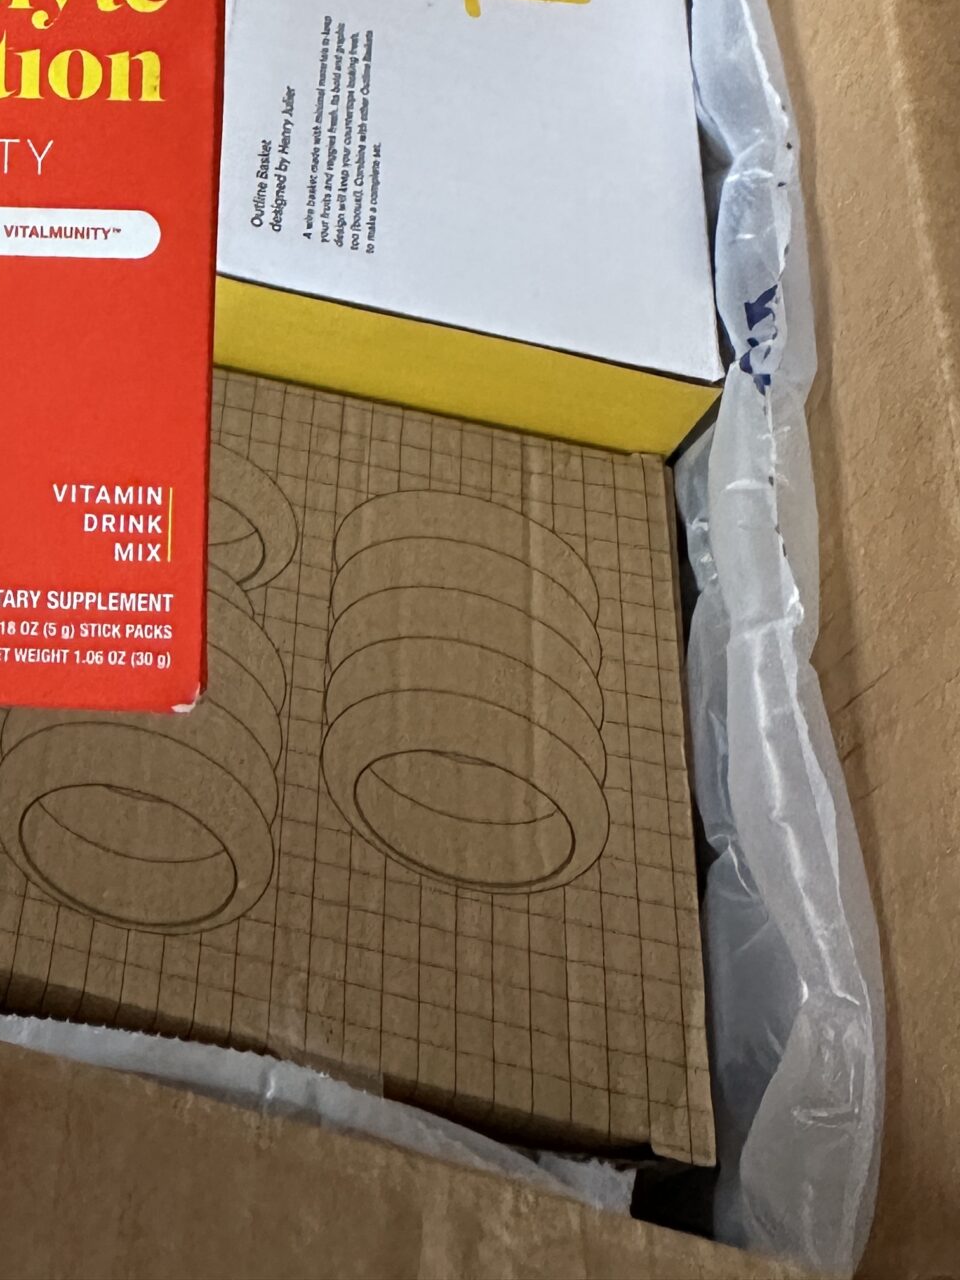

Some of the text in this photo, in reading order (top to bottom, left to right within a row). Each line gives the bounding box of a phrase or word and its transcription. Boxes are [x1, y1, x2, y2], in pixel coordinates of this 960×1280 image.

[278, 119, 294, 154] Henry
[275, 157, 291, 172] by
[250, 139, 272, 228] Outline Basket
[306, 175, 318, 207] basket
[324, 172, 334, 191] and
[269, 174, 287, 233] designed
[320, 194, 331, 218] fruits
[321, 221, 330, 243] your
[333, 214, 347, 248] design
[53, 484, 162, 505] VITAMIN
[84, 514, 162, 533] DRINK
[114, 543, 161, 562] MIX
[47, 591, 174, 612] SUPPLEMENT
[20, 621, 39, 636] OZ
[43, 622, 56, 638] (5
[62, 624, 75, 639] g)
[80, 623, 121, 638] STICK
[126, 624, 172, 639] PACKS
[15, 648, 69, 664] WEIGHT
[74, 650, 103, 665] 1.06
[108, 651, 126, 665] OZ
[131, 652, 153, 668] (30
[157, 652, 171, 669] g)
